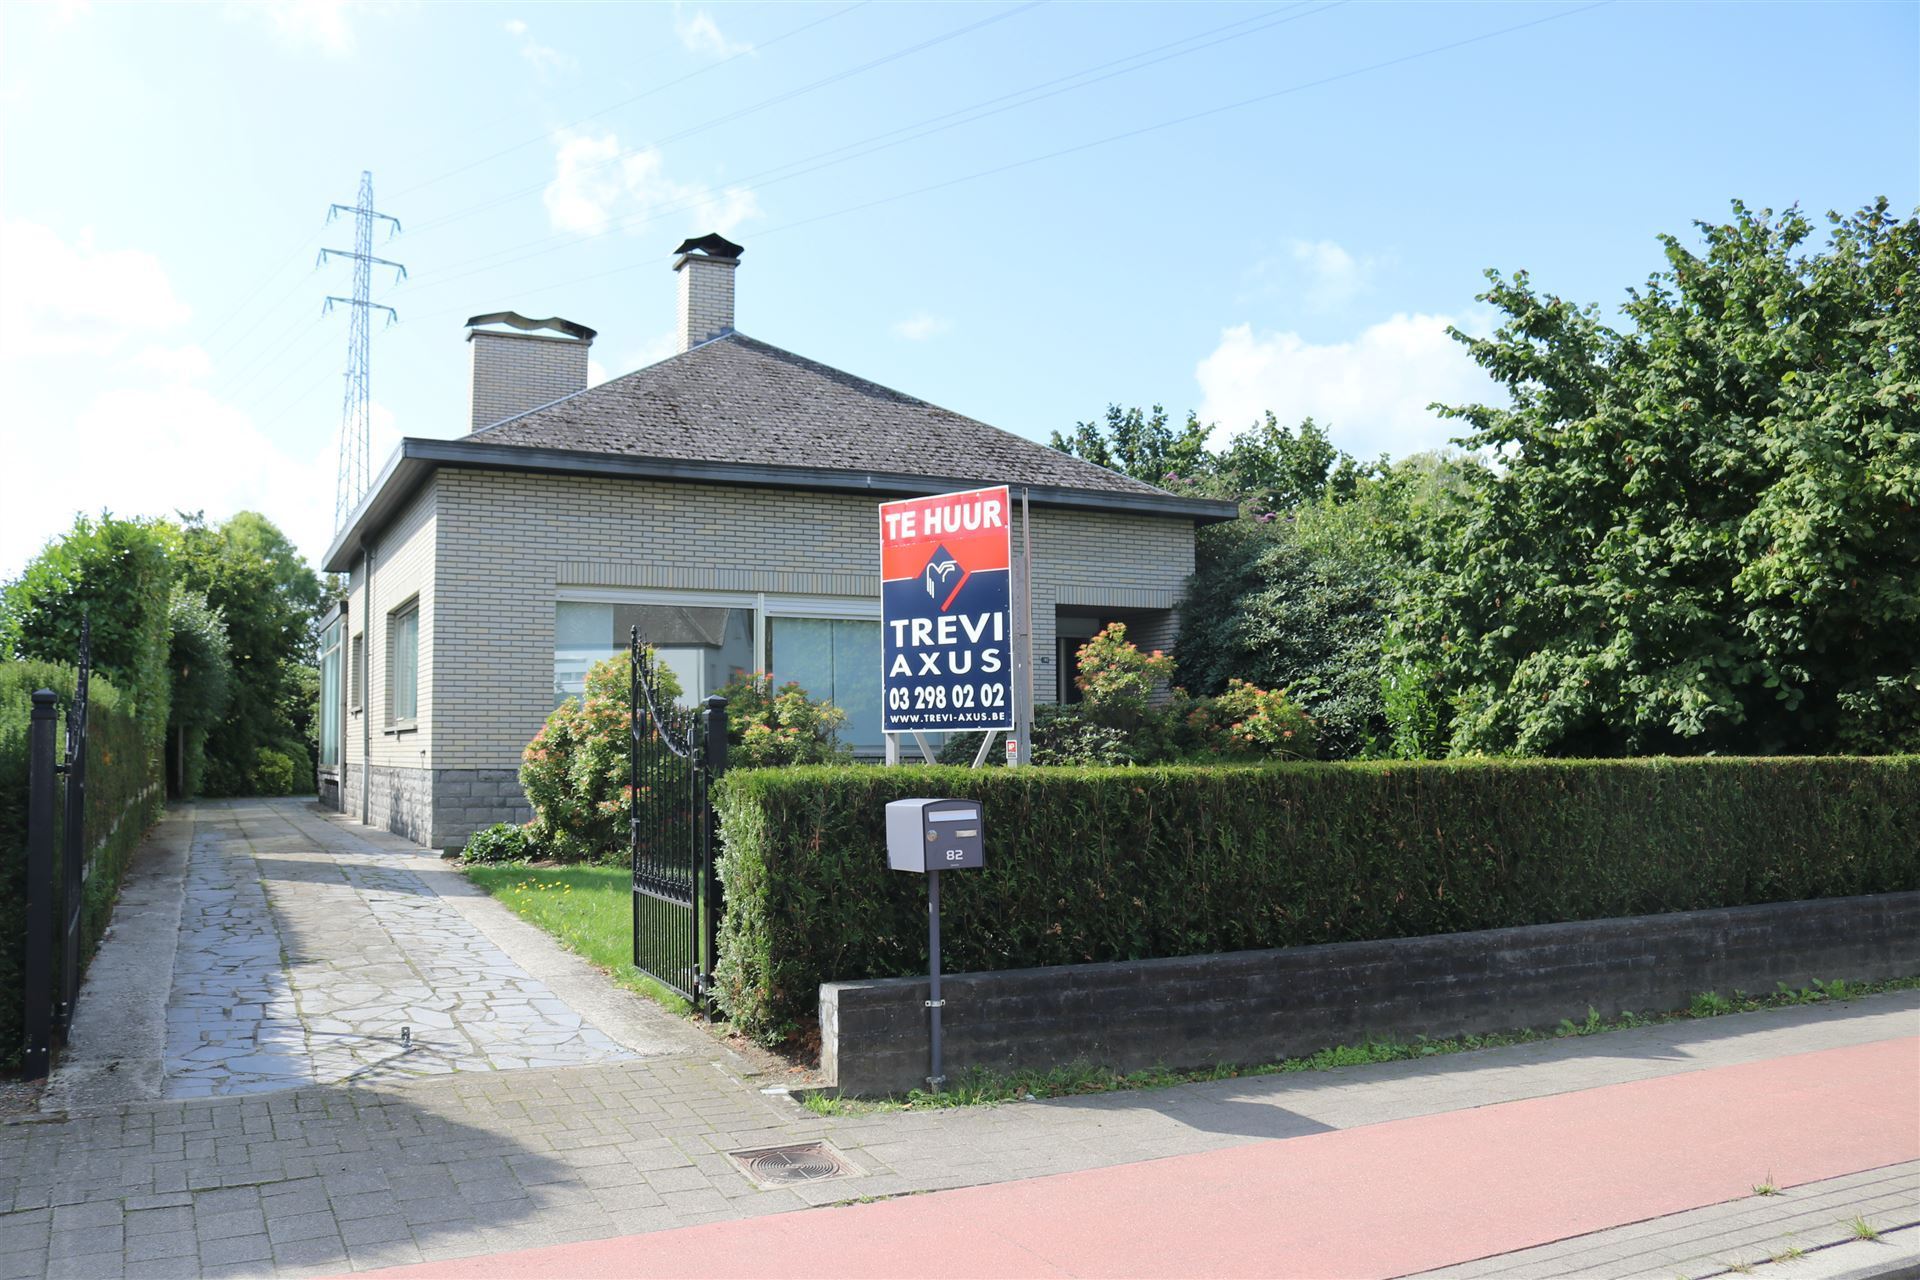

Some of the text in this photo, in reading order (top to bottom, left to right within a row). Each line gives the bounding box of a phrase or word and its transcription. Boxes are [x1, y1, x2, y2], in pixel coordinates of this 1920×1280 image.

[885, 500, 1002, 540] TE HUUR
[890, 612, 1003, 647] TREVI
[889, 648, 1001, 677] AXUS
[889, 683, 1005, 710] 03 298 02 02
[890, 712, 1005, 723] WWW.TREVI-AXUS.BE
[946, 850, 963, 860] 82
